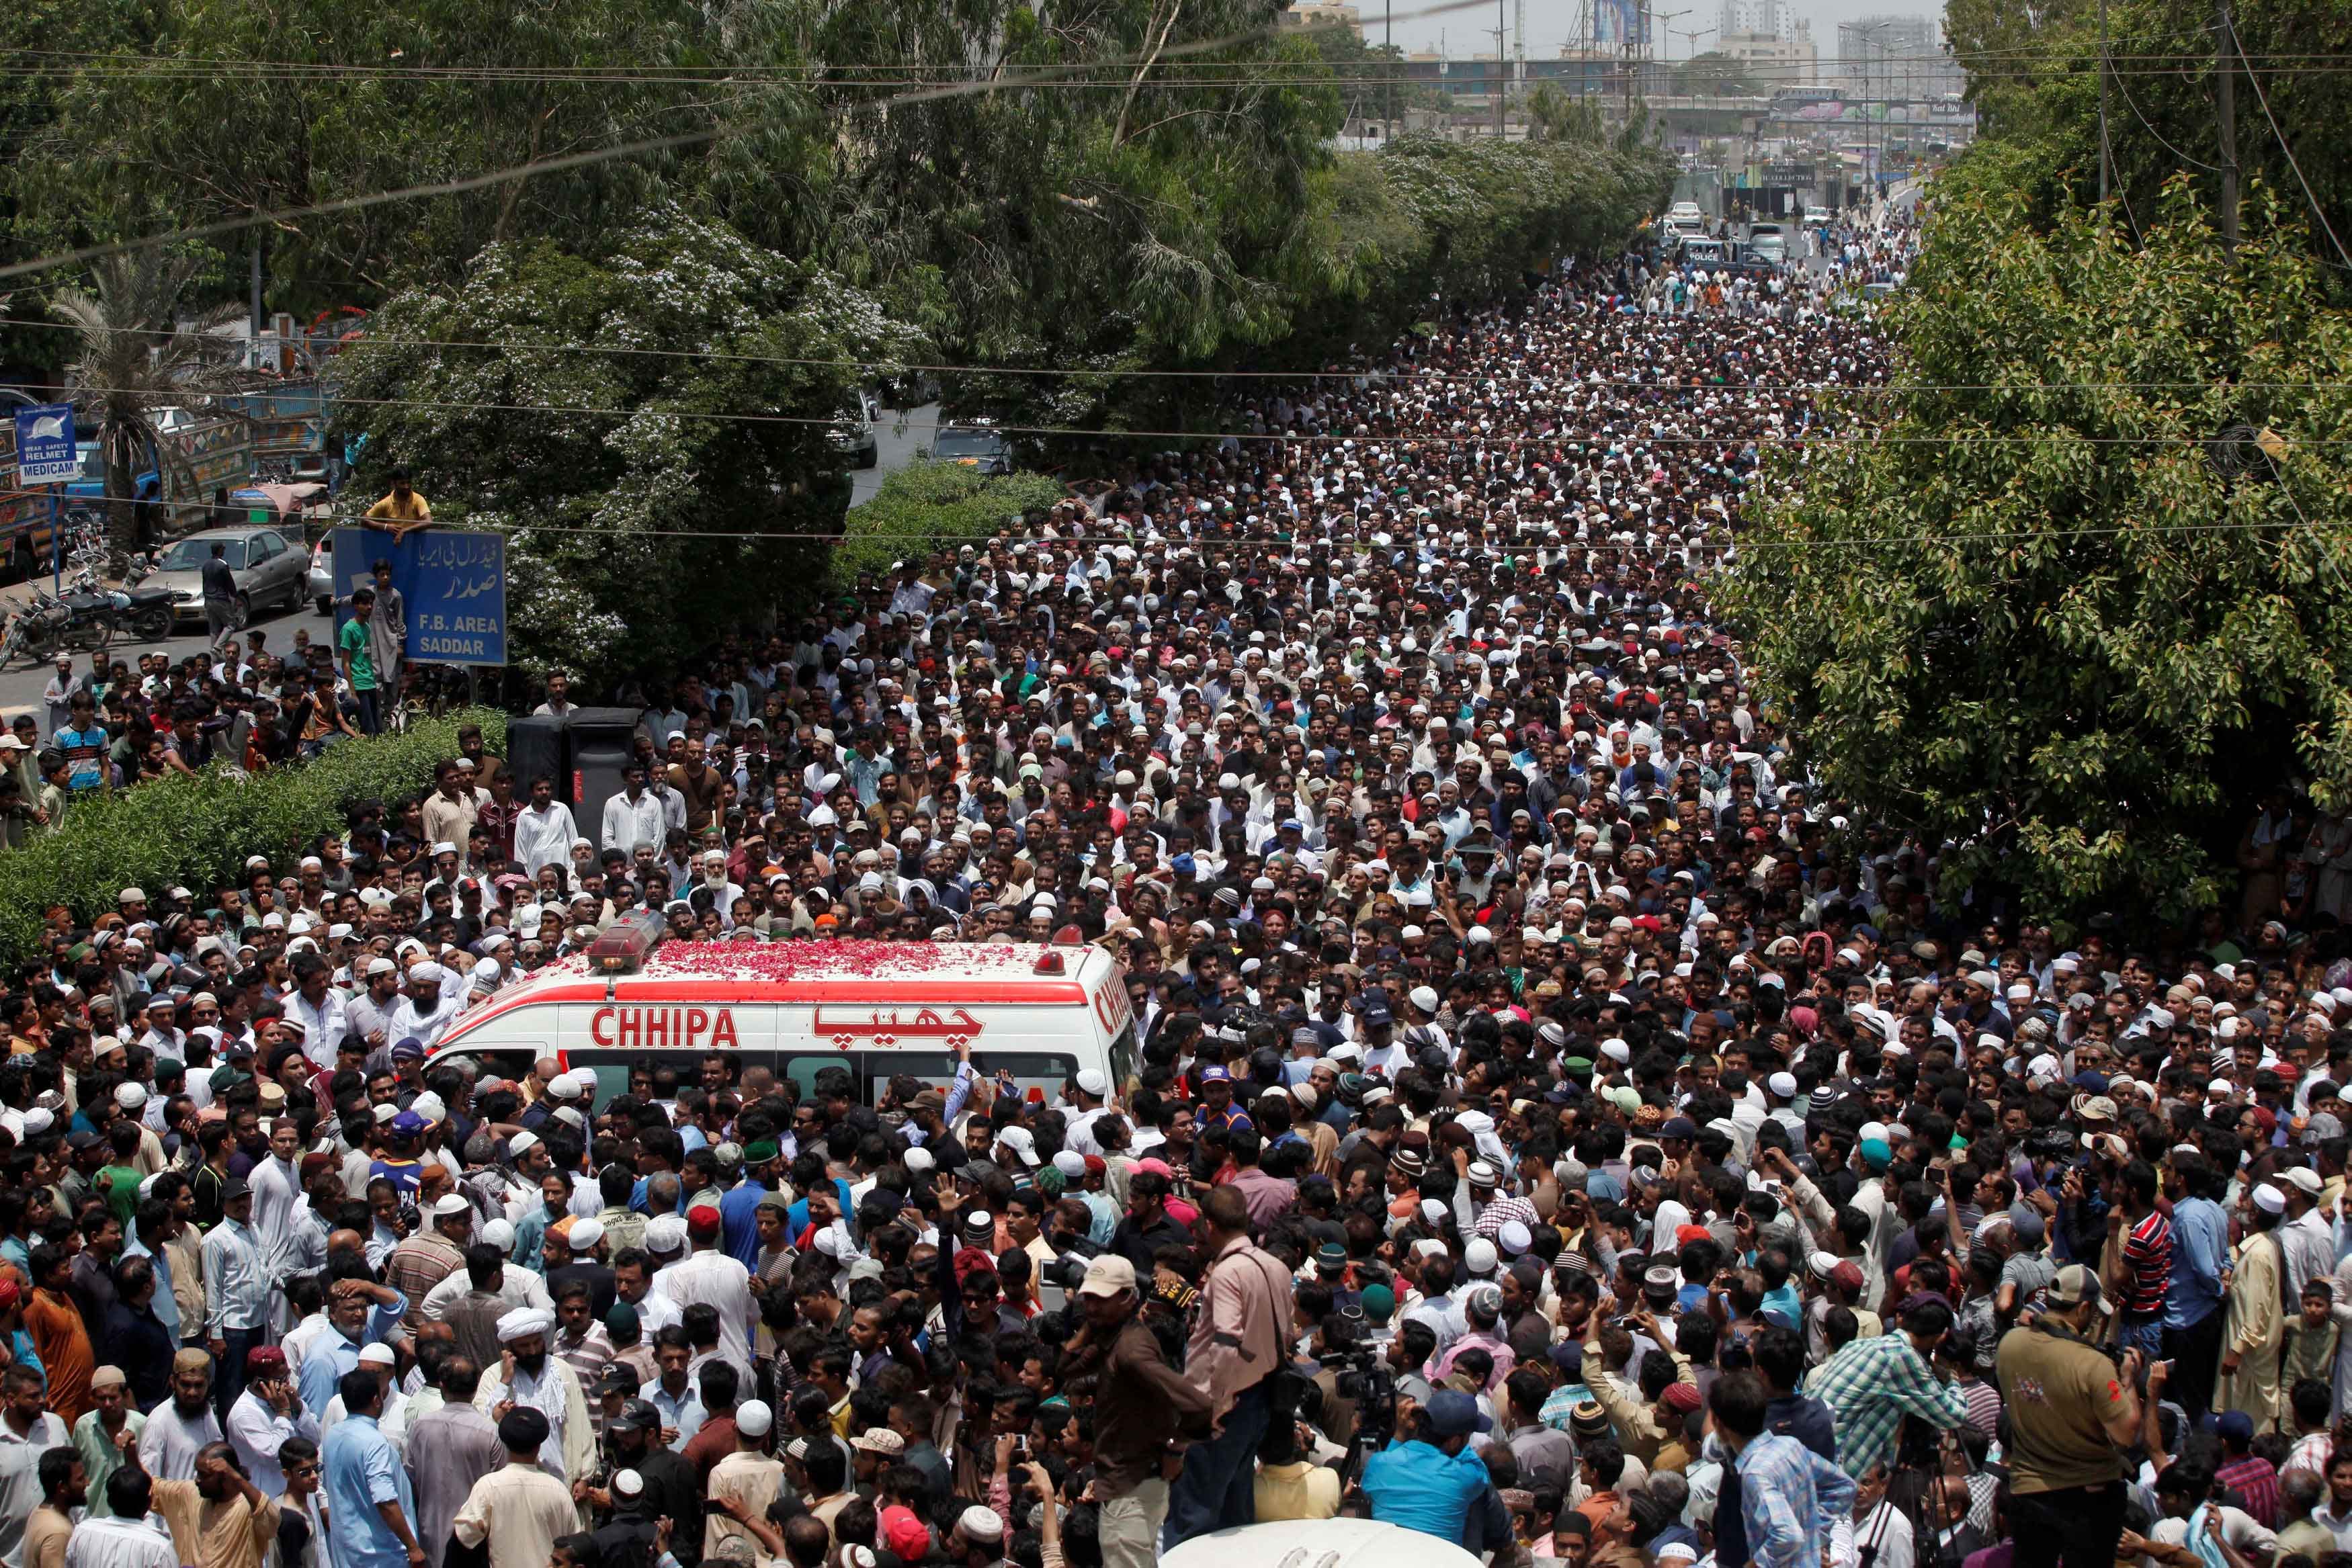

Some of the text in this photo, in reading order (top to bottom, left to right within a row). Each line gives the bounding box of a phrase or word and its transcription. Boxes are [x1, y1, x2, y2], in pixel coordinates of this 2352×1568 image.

[1689, 253, 1718, 261] POLICE
[26, 450, 68, 461] HELMET
[24, 462, 74, 477] MEDICAM
[419, 614, 499, 634] F.B. AREA
[420, 636, 485, 656] SADDAR
[590, 1007, 740, 1048] CHHIPA
